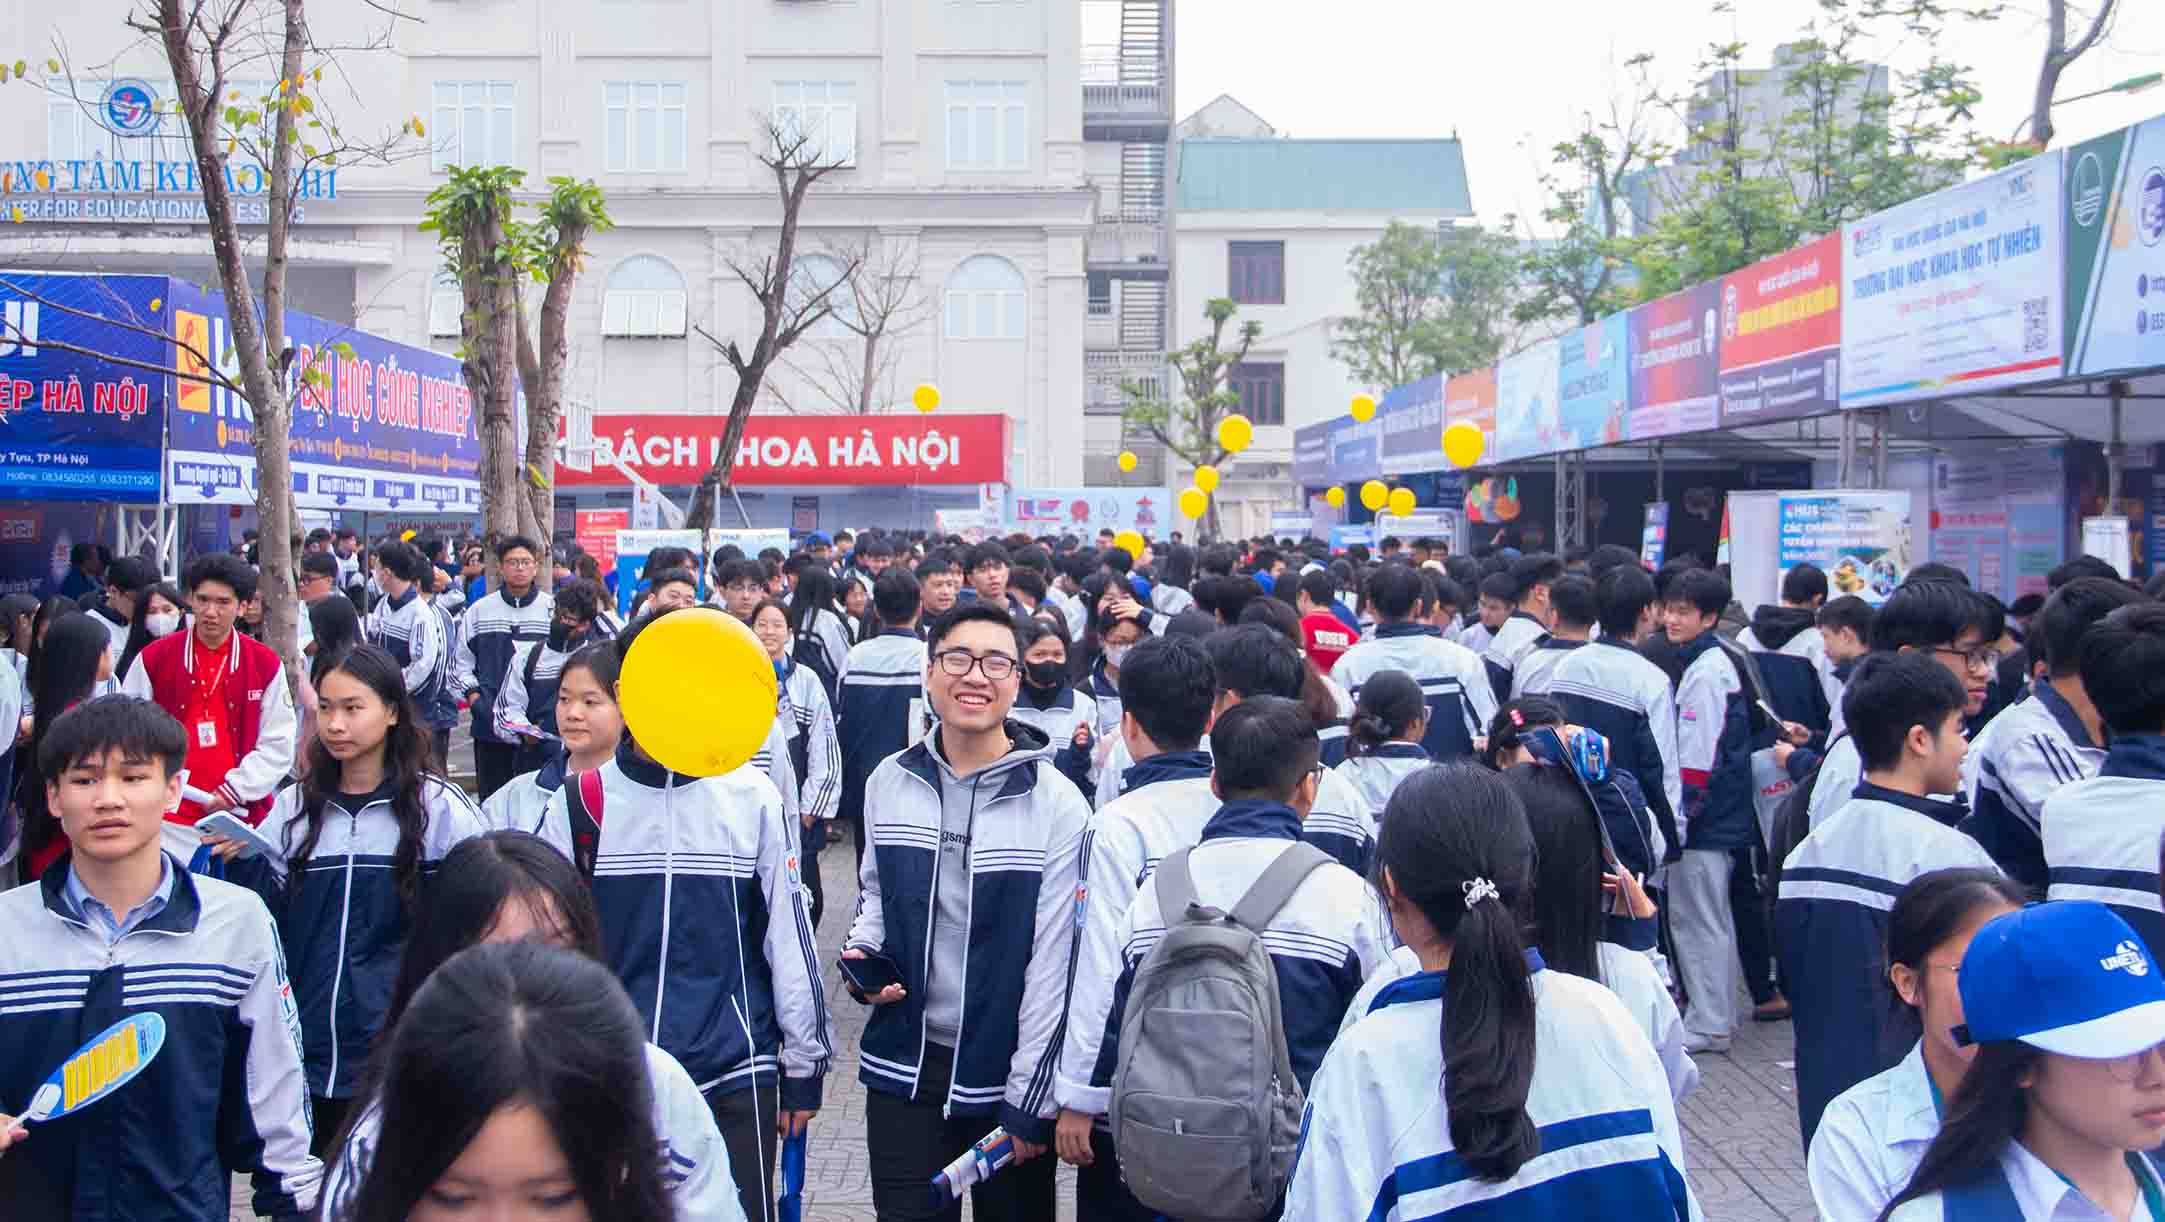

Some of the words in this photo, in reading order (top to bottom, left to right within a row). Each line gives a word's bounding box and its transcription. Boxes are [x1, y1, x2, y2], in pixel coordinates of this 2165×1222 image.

[45, 200, 80, 218] FOR
[1930, 249, 1959, 279] KHOA
[42, 374, 85, 413] HÀ
[94, 376, 148, 421] NỘI
[337, 349, 372, 432] HỌC
[37, 453, 51, 464] TP
[592, 427, 698, 466] BÁCH
[829, 428, 882, 467] HÀ
[892, 430, 960, 471] NỘI
